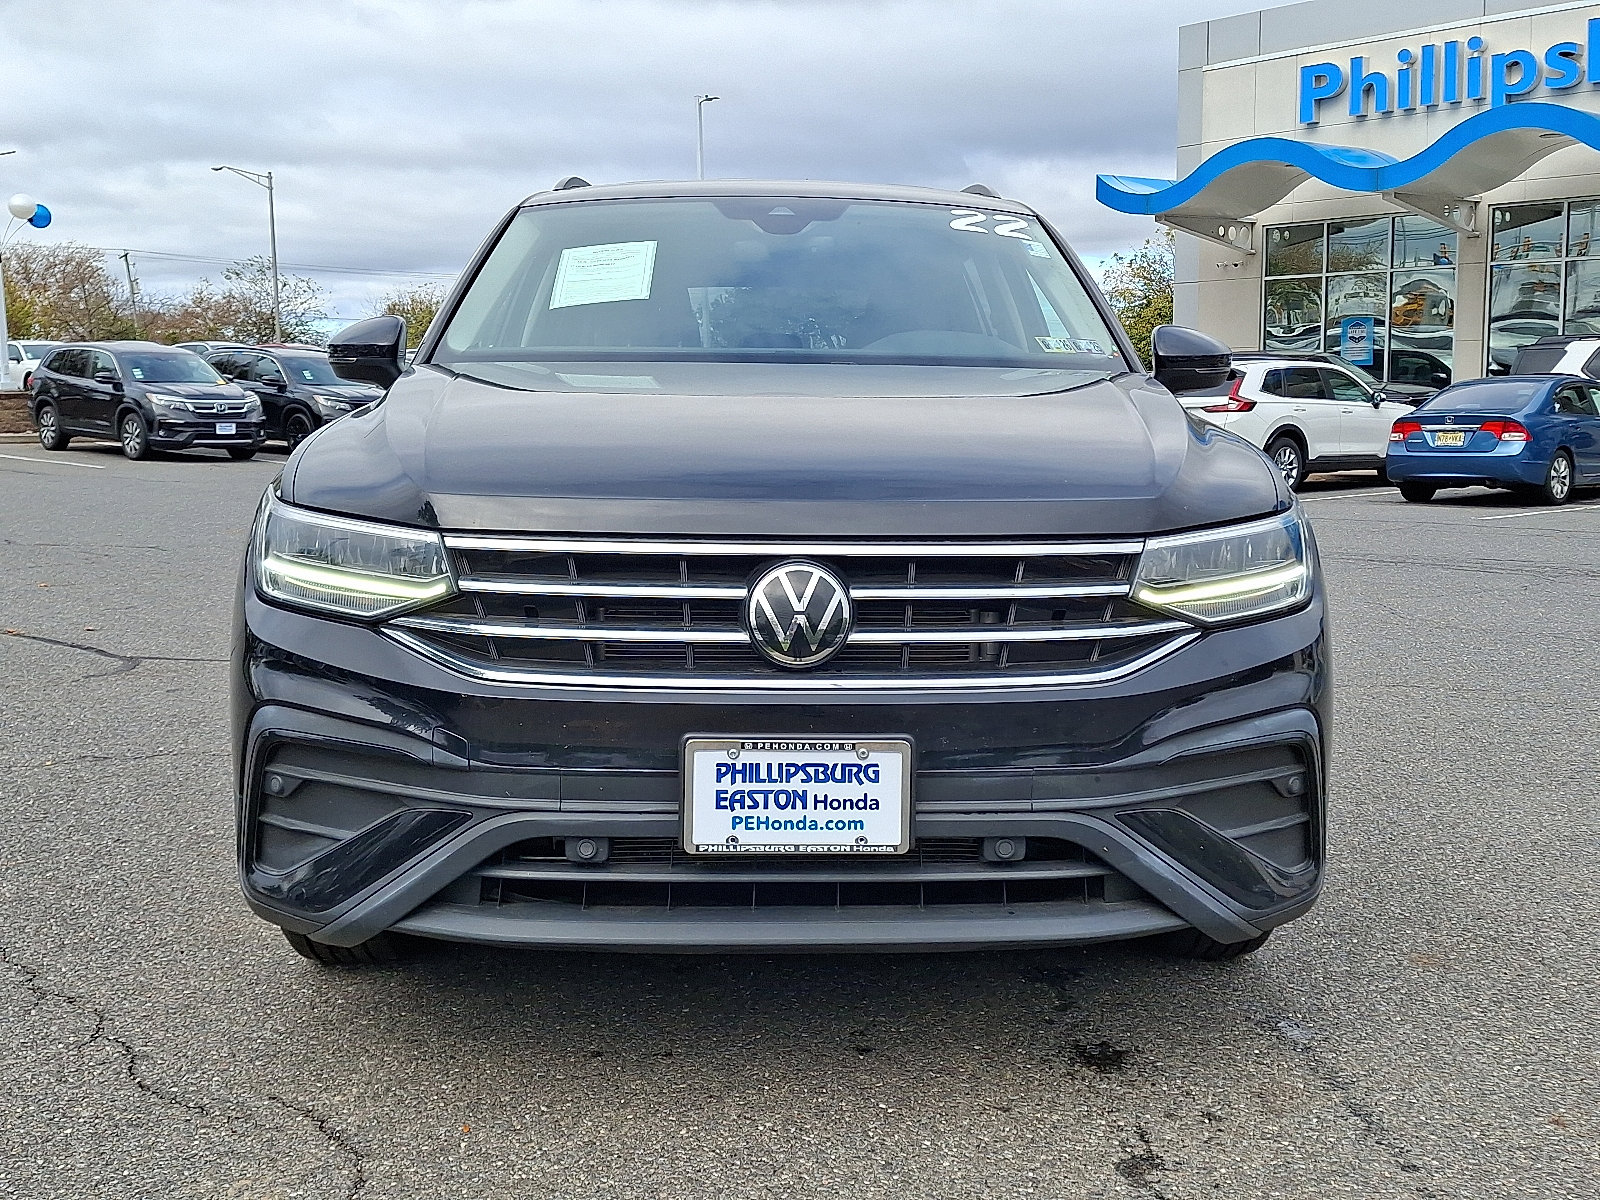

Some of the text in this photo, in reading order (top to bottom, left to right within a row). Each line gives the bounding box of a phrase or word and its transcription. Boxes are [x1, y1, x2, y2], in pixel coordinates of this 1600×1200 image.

[1300, 18, 1600, 124] Phillips
[949, 209, 1033, 240] 22
[757, 742, 840, 750] PEHONDA.COM
[715, 763, 880, 786] PHILLIPSBURG
[715, 789, 880, 812] EASTON Honda
[731, 815, 865, 831] PEHonda.com
[698, 845, 795, 853] PHILLIPSBURG
[853, 845, 895, 853] Honda
